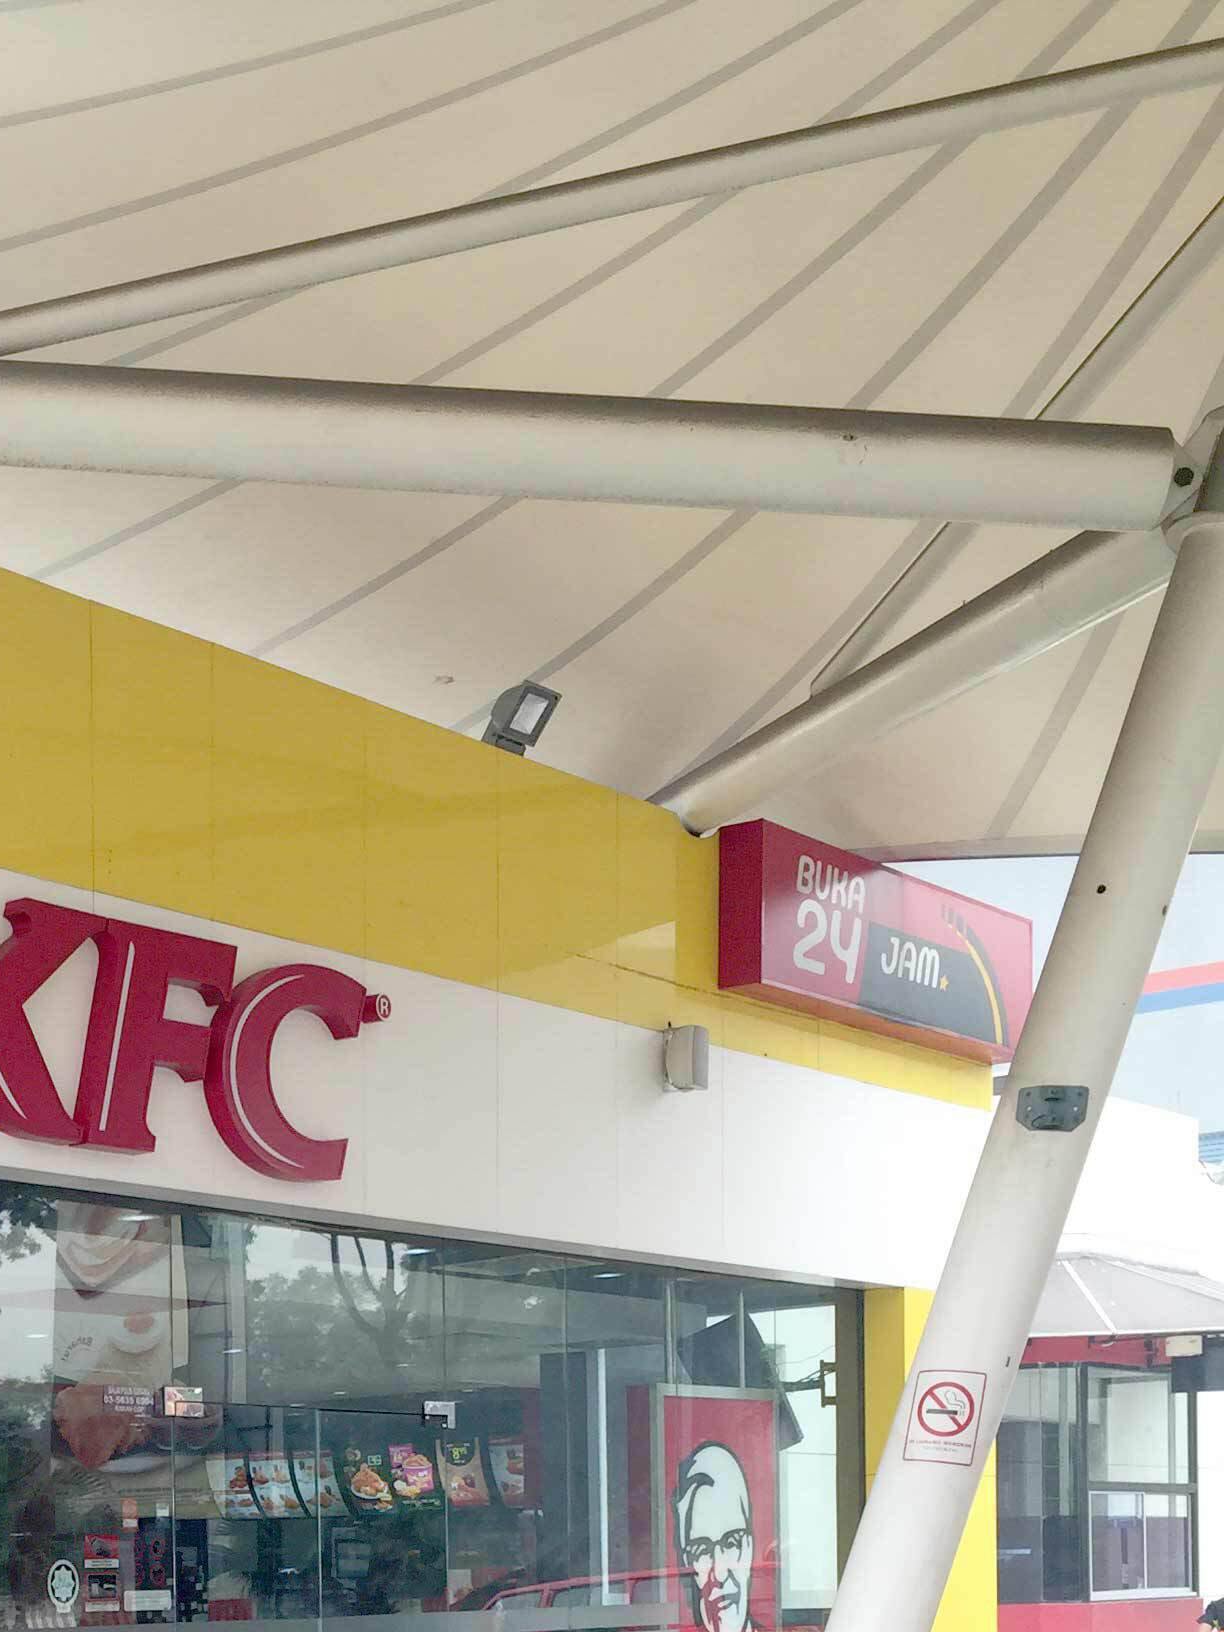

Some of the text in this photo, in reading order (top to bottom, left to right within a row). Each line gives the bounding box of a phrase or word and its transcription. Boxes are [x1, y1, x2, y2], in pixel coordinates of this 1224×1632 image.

[796, 855, 866, 914] BUKA
[793, 899, 940, 988] 24 JAM
